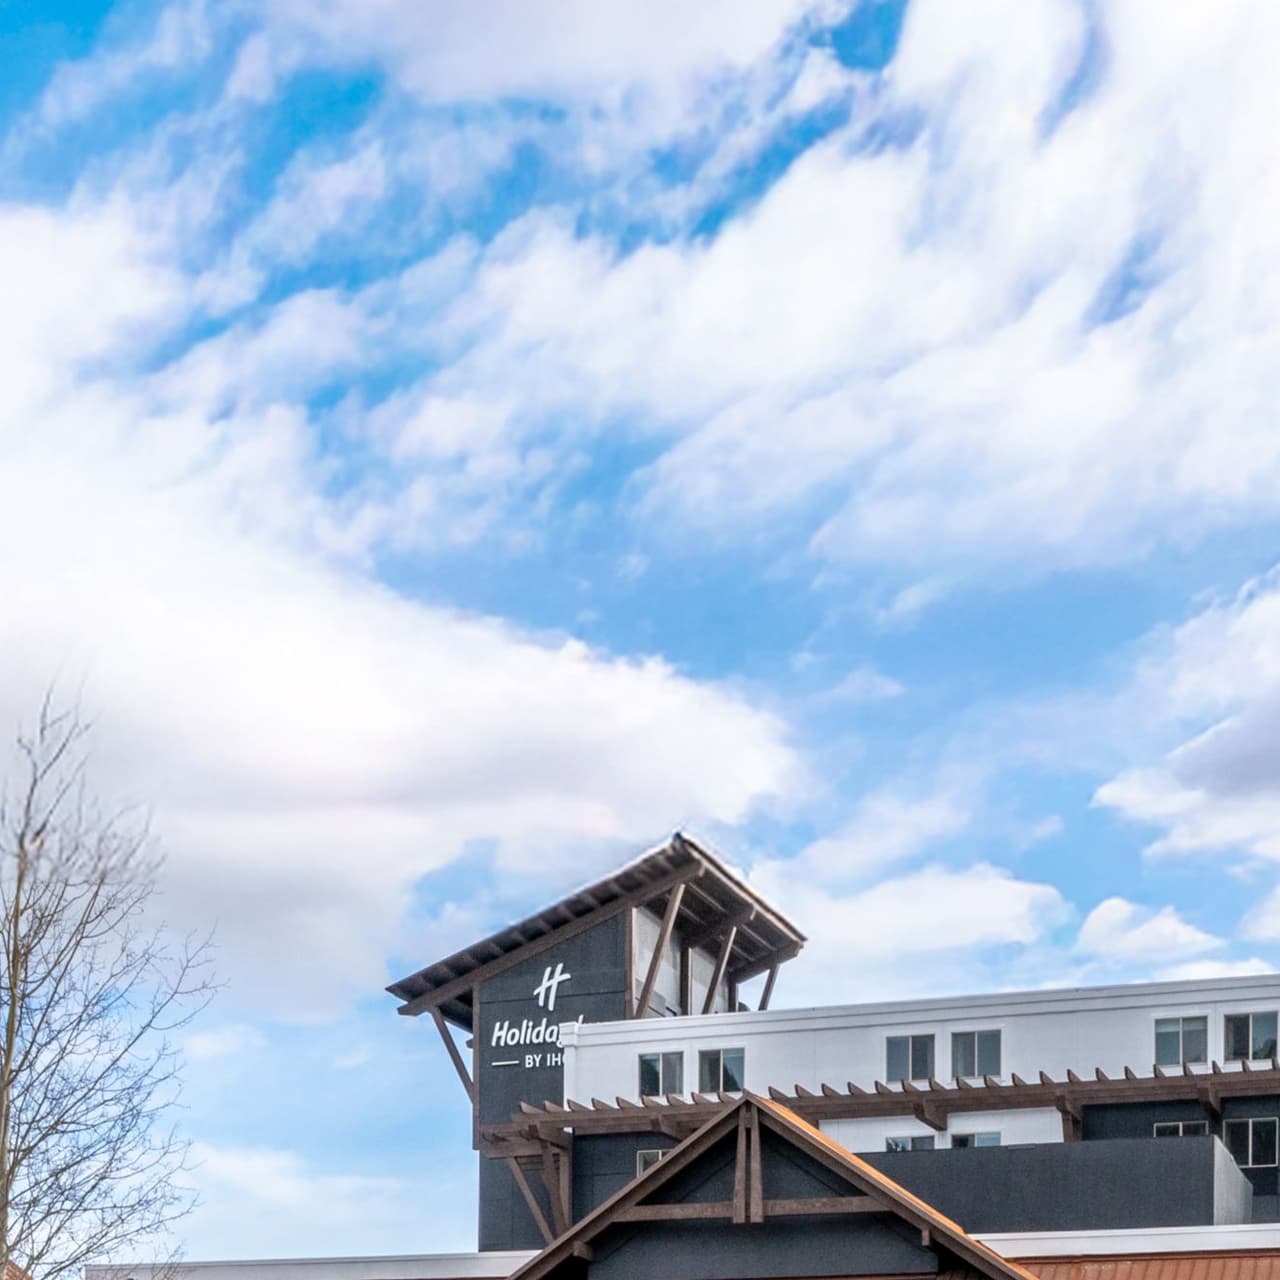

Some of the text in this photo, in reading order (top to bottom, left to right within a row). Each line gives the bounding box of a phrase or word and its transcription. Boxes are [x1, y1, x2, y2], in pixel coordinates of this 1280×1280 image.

[491, 1017, 565, 1048] Holida
[525, 1052, 566, 1068] BY IH
